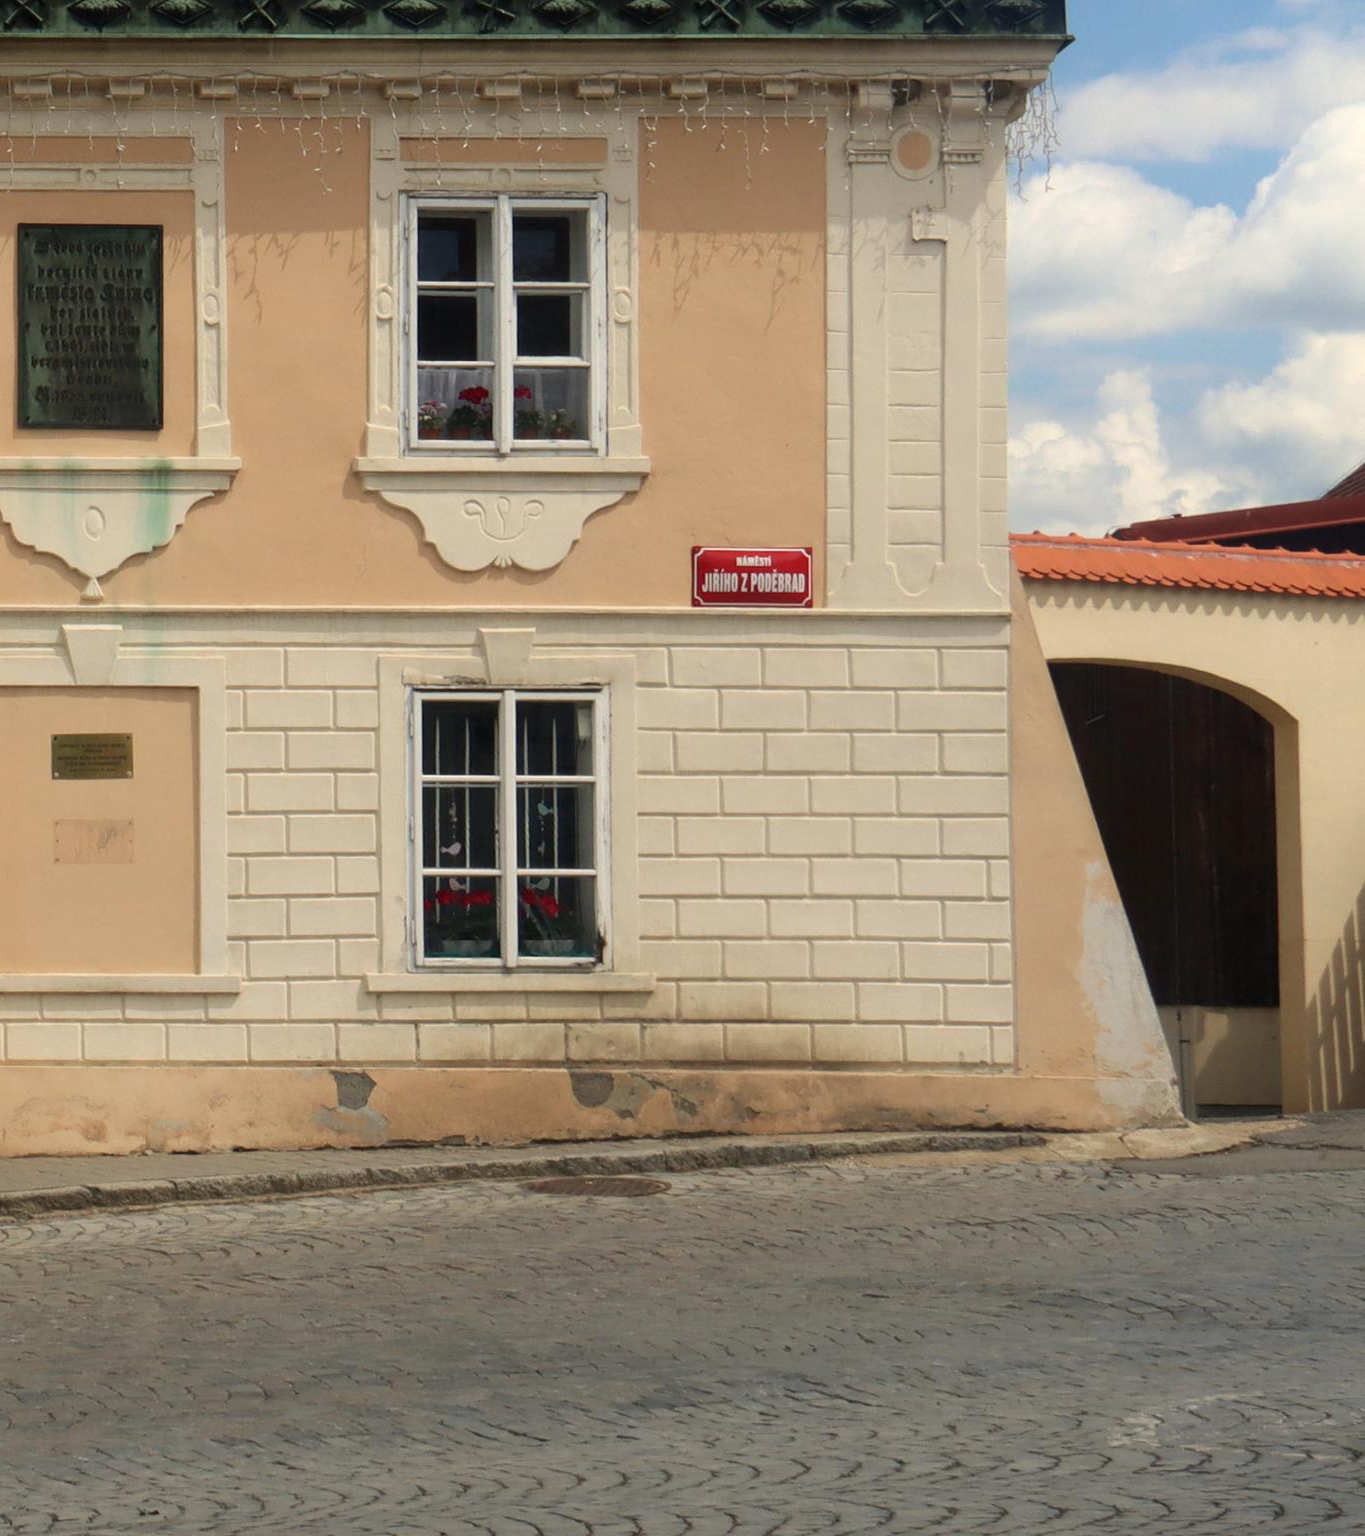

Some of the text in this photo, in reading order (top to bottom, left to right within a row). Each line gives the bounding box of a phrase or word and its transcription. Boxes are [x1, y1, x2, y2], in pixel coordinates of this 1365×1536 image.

[736, 555, 772, 567] NÁMĚSTÍ
[702, 569, 806, 593] JIŘÍHO Z PODĚBRAD
